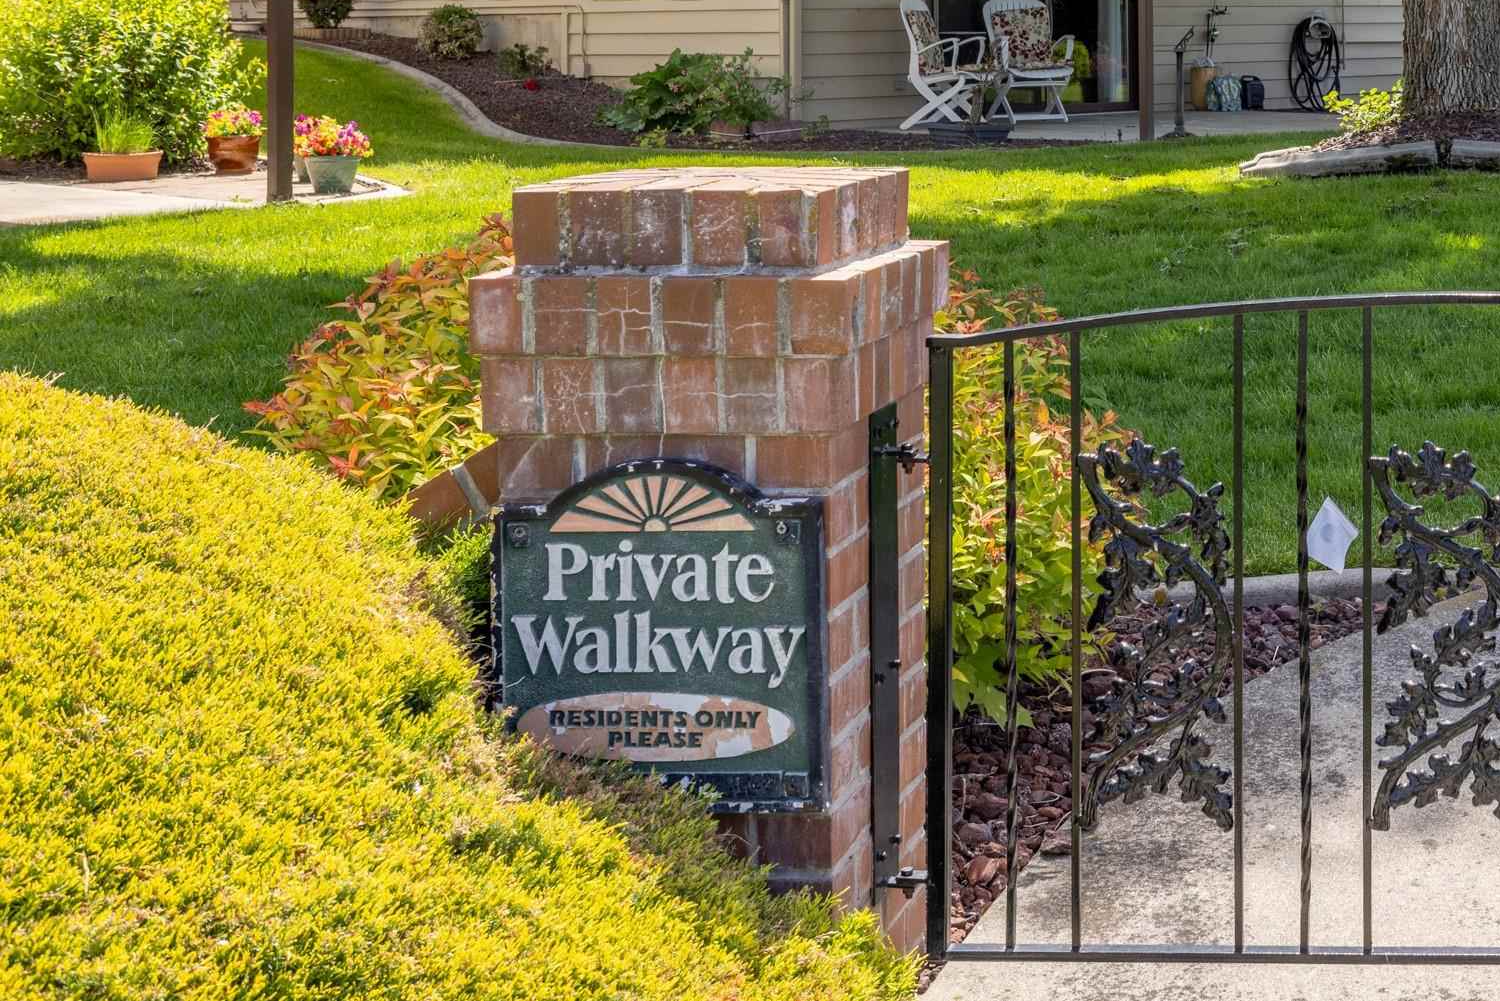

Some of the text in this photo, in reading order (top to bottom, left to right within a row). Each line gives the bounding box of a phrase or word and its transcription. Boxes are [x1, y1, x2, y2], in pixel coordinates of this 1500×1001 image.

[542, 539, 775, 604] Private
[511, 609, 806, 689] Walkway
[550, 709, 762, 729] RESIDENTS ONLY
[607, 731, 704, 750] PLEASE
